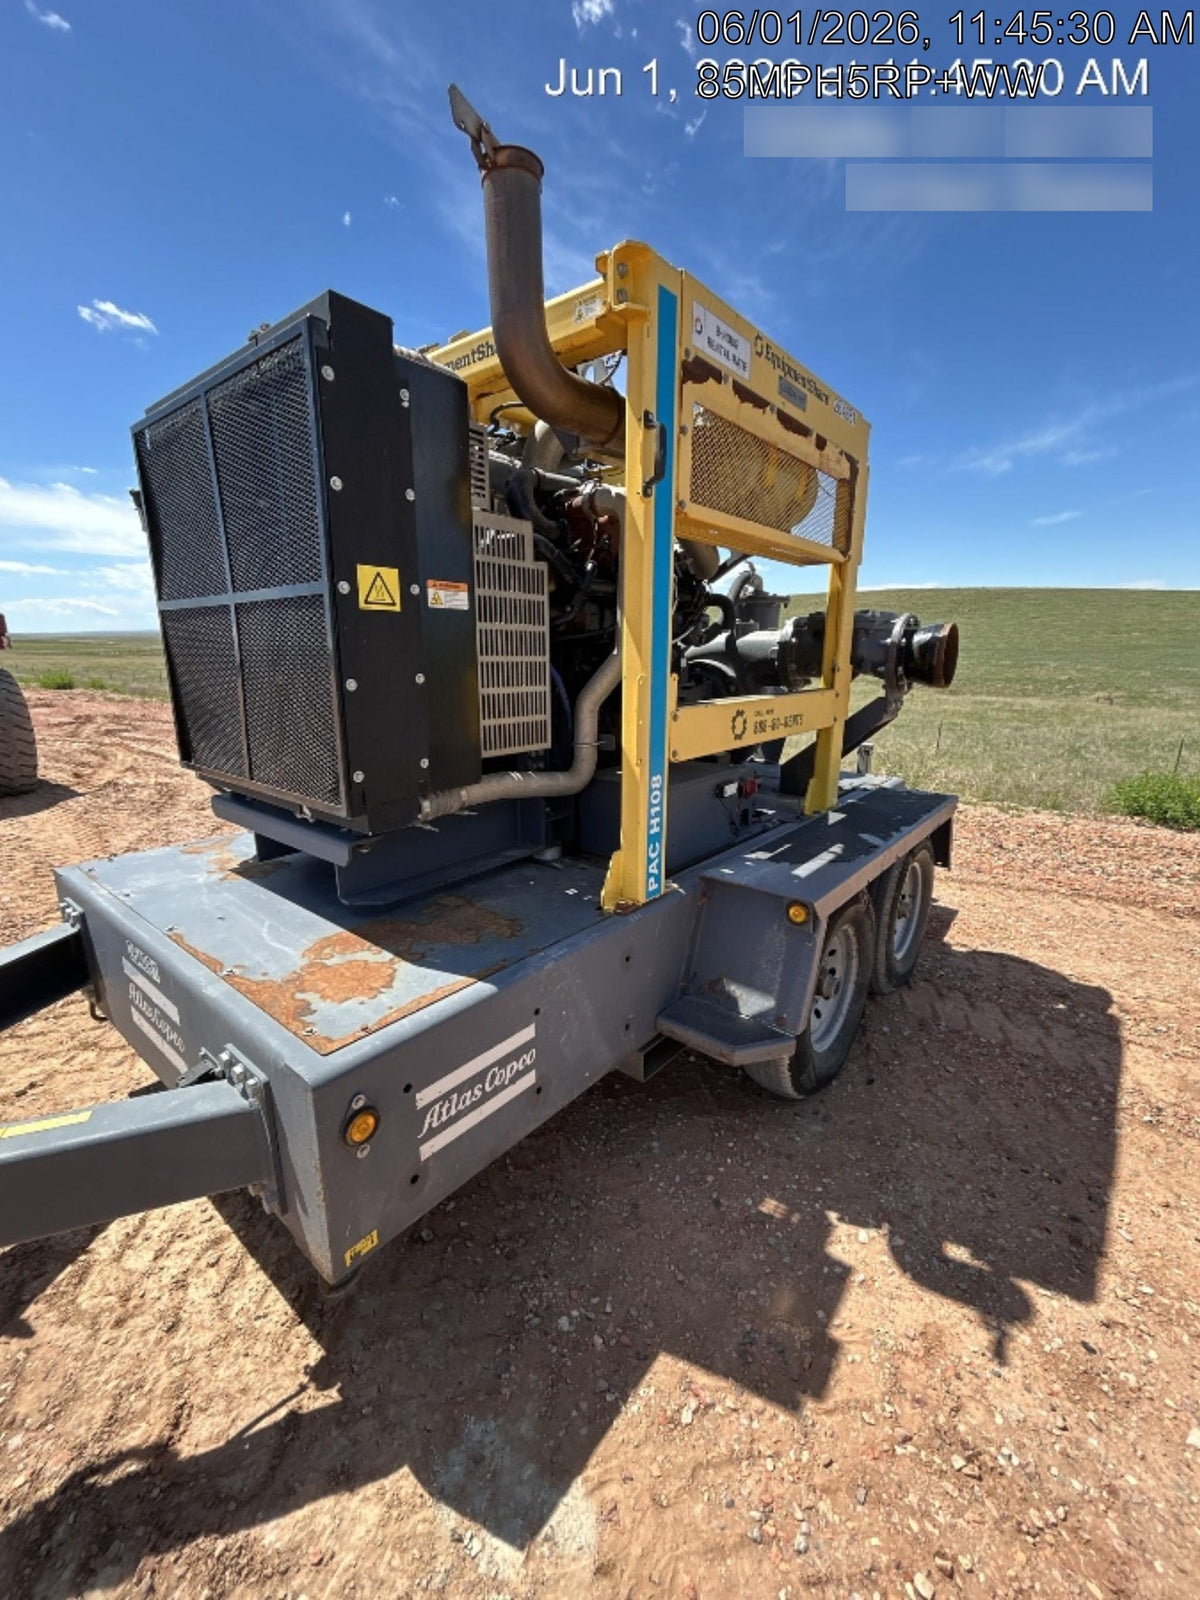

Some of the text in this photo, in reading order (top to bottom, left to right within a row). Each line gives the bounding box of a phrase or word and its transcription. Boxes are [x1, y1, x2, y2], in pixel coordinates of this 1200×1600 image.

[648, 841, 660, 892] PAC
[417, 1048, 536, 1139] Atlas Copco
